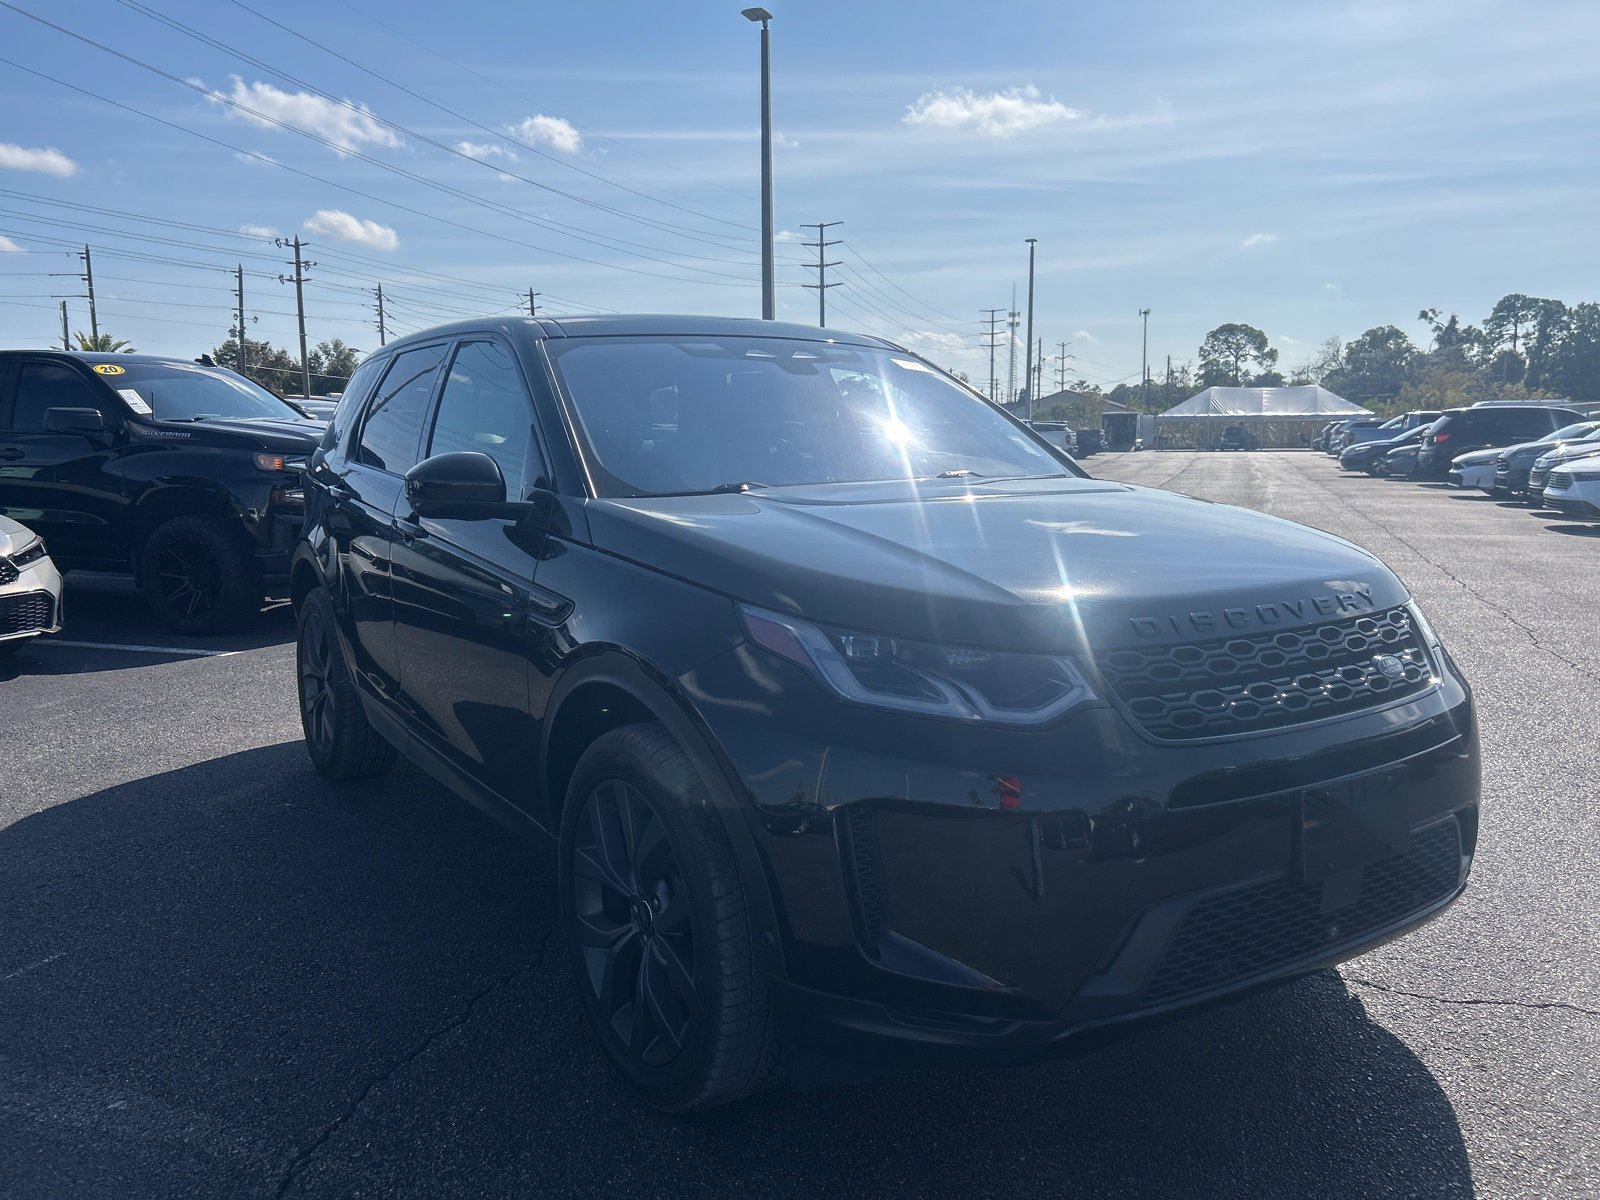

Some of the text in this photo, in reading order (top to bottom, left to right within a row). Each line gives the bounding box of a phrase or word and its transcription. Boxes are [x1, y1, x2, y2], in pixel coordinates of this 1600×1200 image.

[100, 365, 118, 373] 20
[142, 430, 192, 438] SILVERADO
[1130, 588, 1375, 638] DISCOVERY
